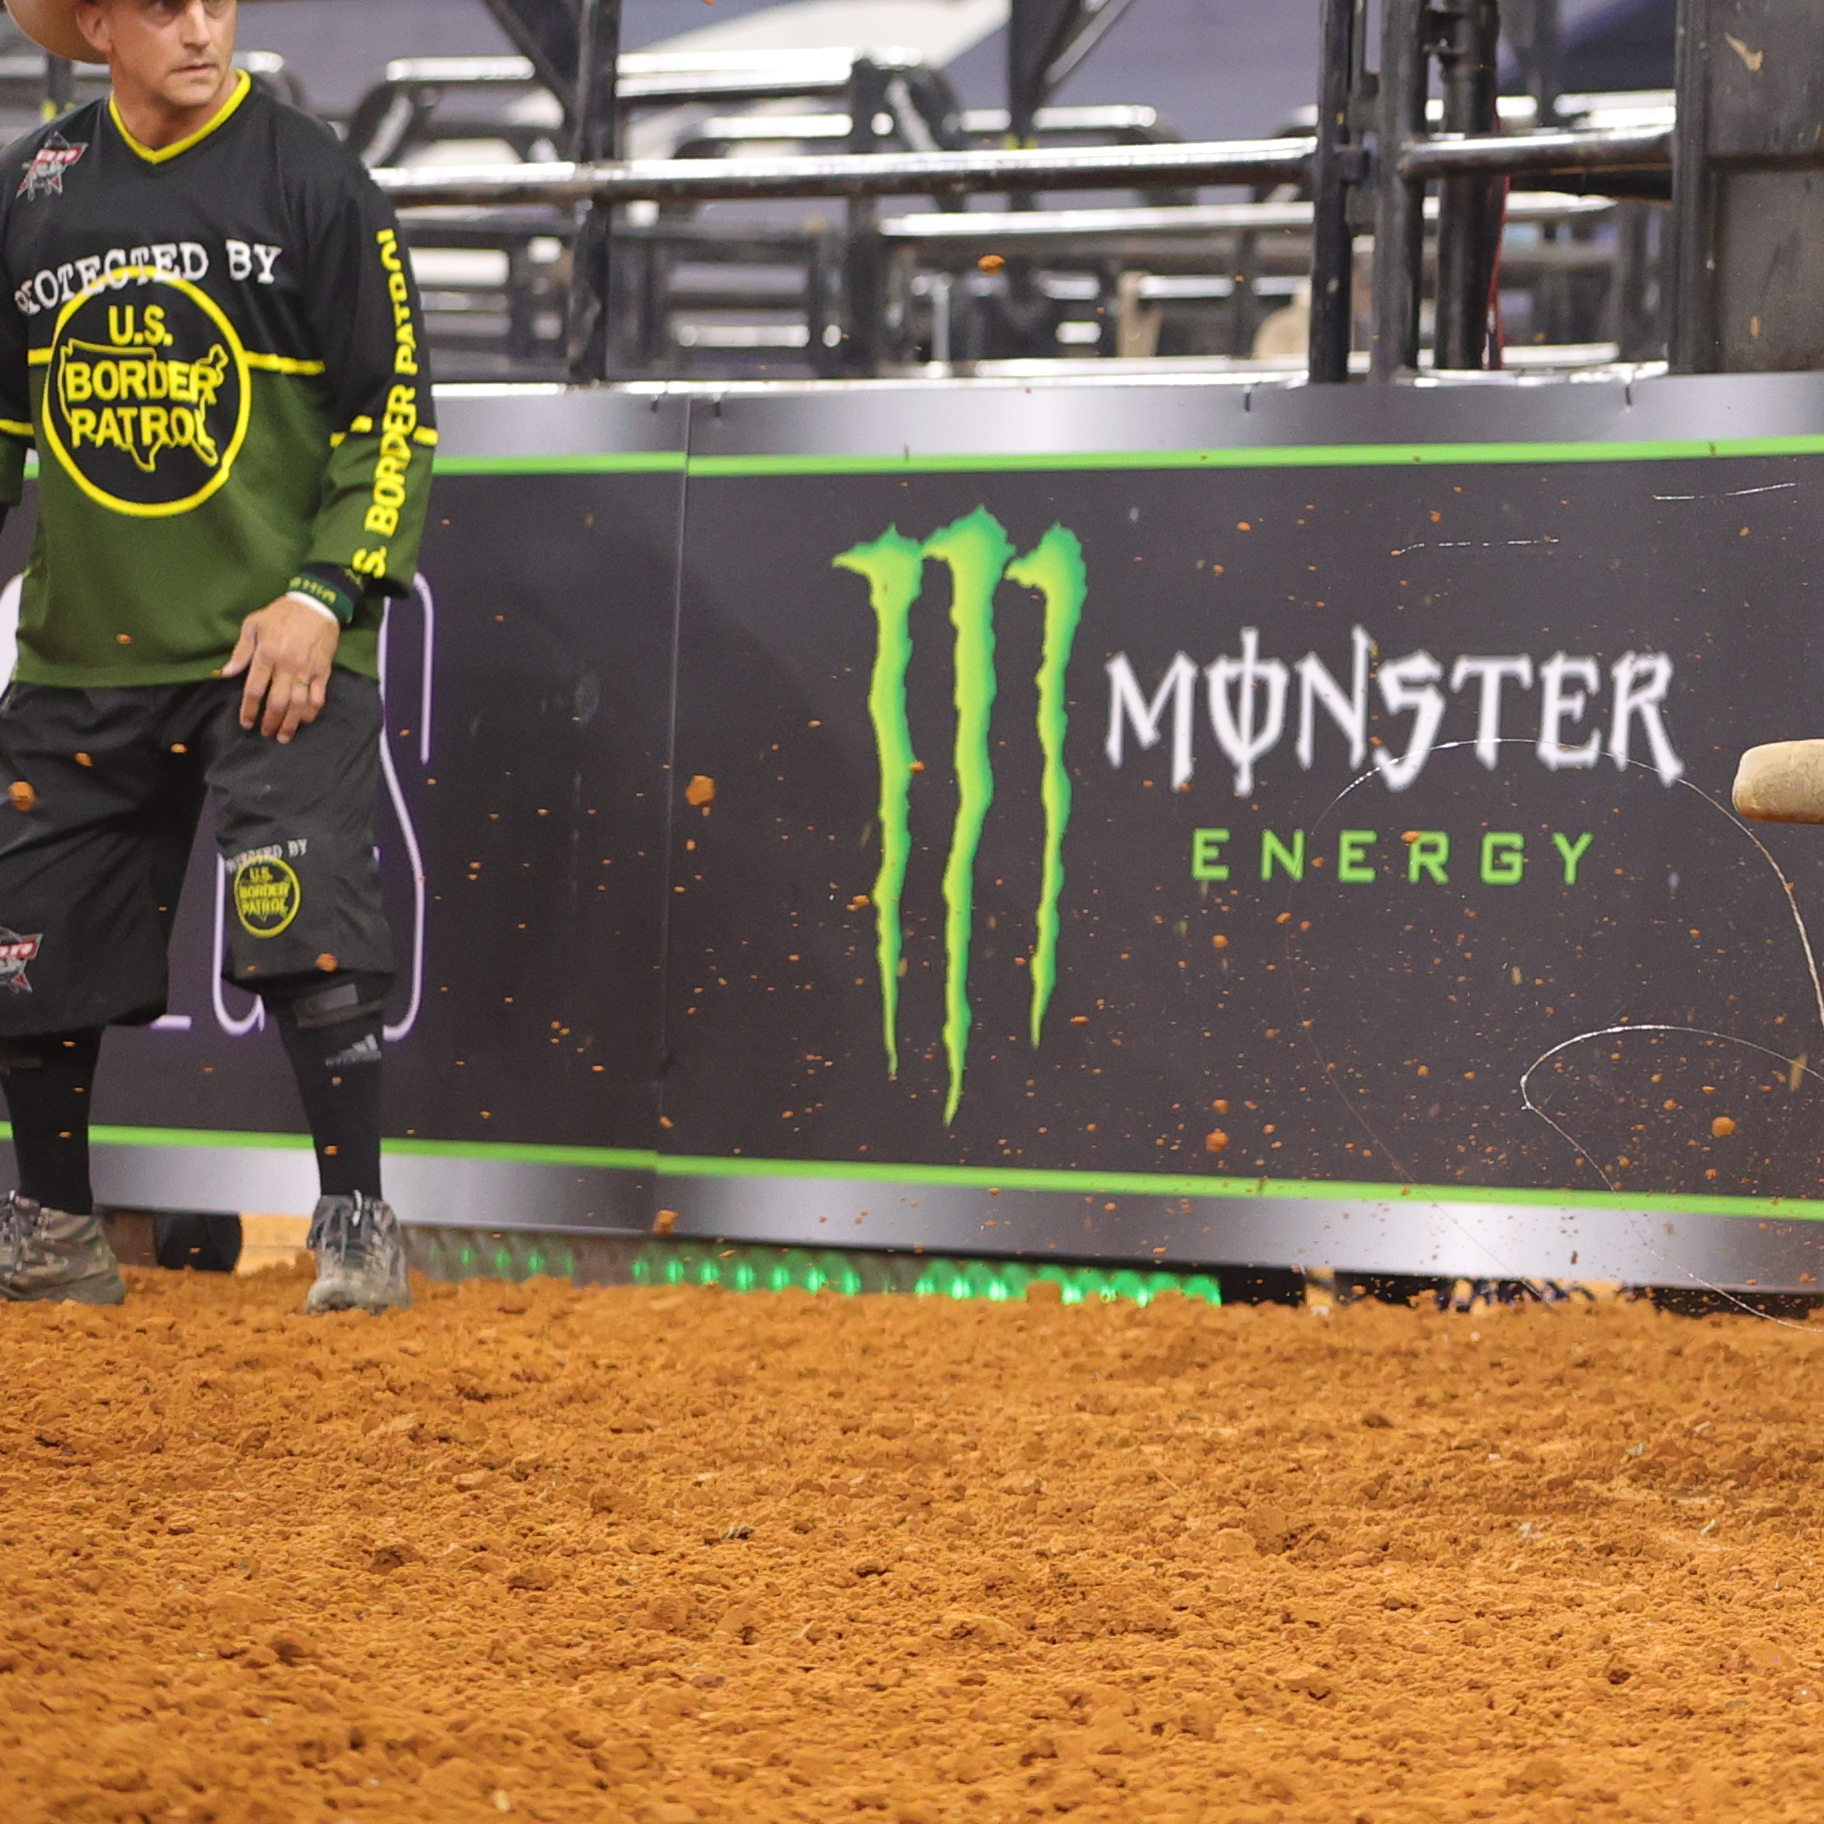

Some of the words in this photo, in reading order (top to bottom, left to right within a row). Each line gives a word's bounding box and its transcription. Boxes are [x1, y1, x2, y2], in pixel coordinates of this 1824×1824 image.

[225, 238, 283, 285] BY
[107, 304, 174, 347] U.S.
[64, 359, 217, 406] BORDER
[70, 405, 216, 449] PATROL
[365, 384, 418, 538] BORDER
[1105, 625, 1684, 795] MONSTER
[287, 838, 308, 858] BY
[1192, 828, 1595, 885] ENERGY
